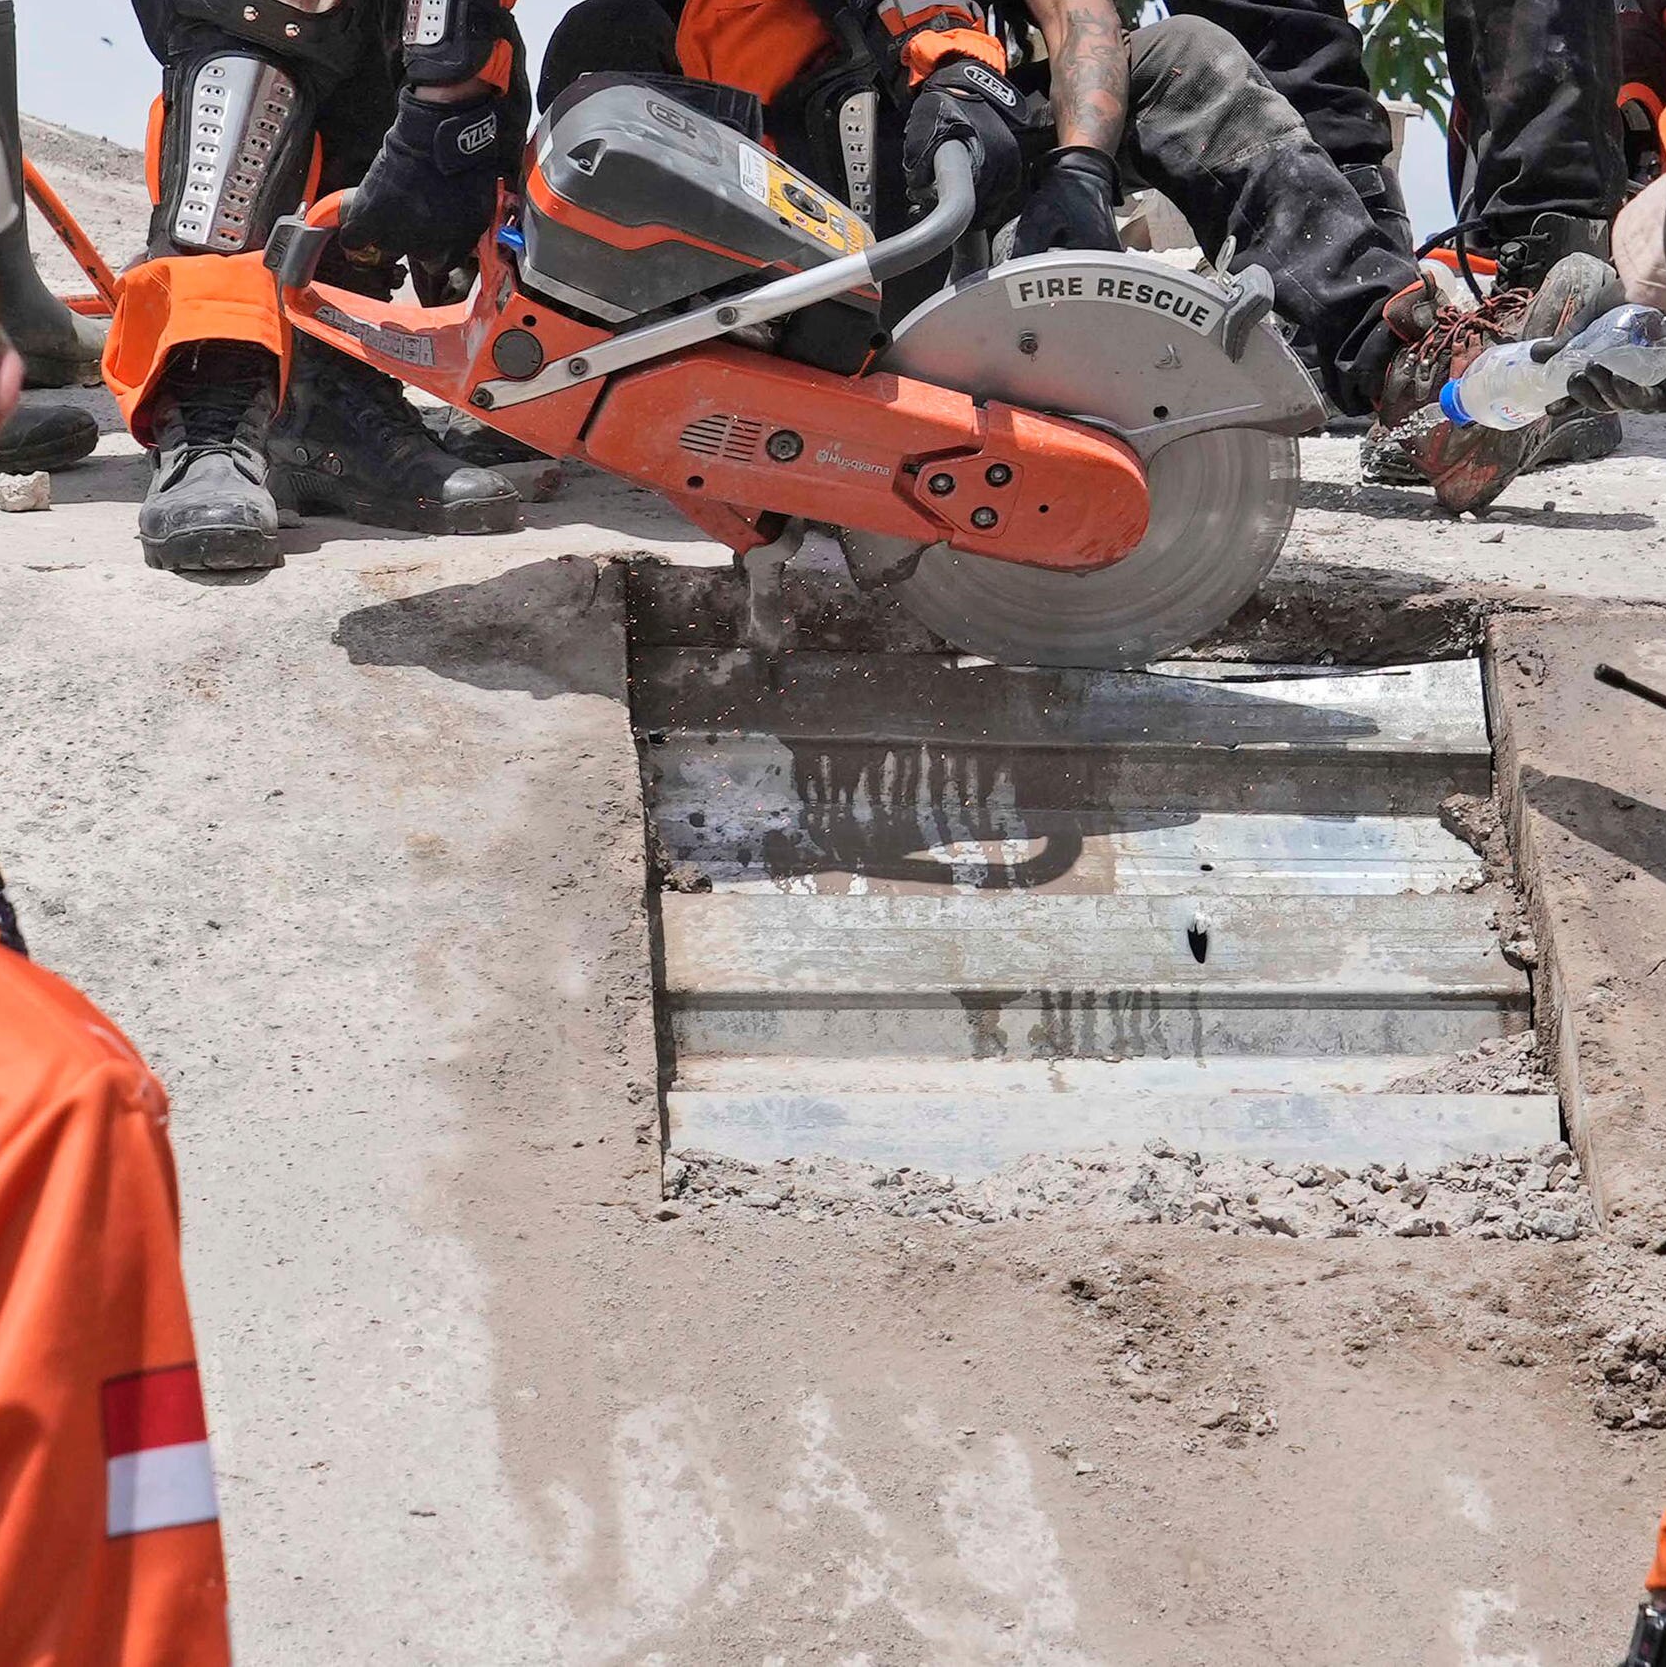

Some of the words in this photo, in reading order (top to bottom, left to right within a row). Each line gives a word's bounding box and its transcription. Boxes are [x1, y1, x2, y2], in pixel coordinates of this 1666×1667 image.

[965, 66, 1017, 107] PETZL
[1019, 276, 1083, 302] FIRE
[1097, 277, 1210, 328] RESCUE
[828, 452, 891, 476] Husqvarna
